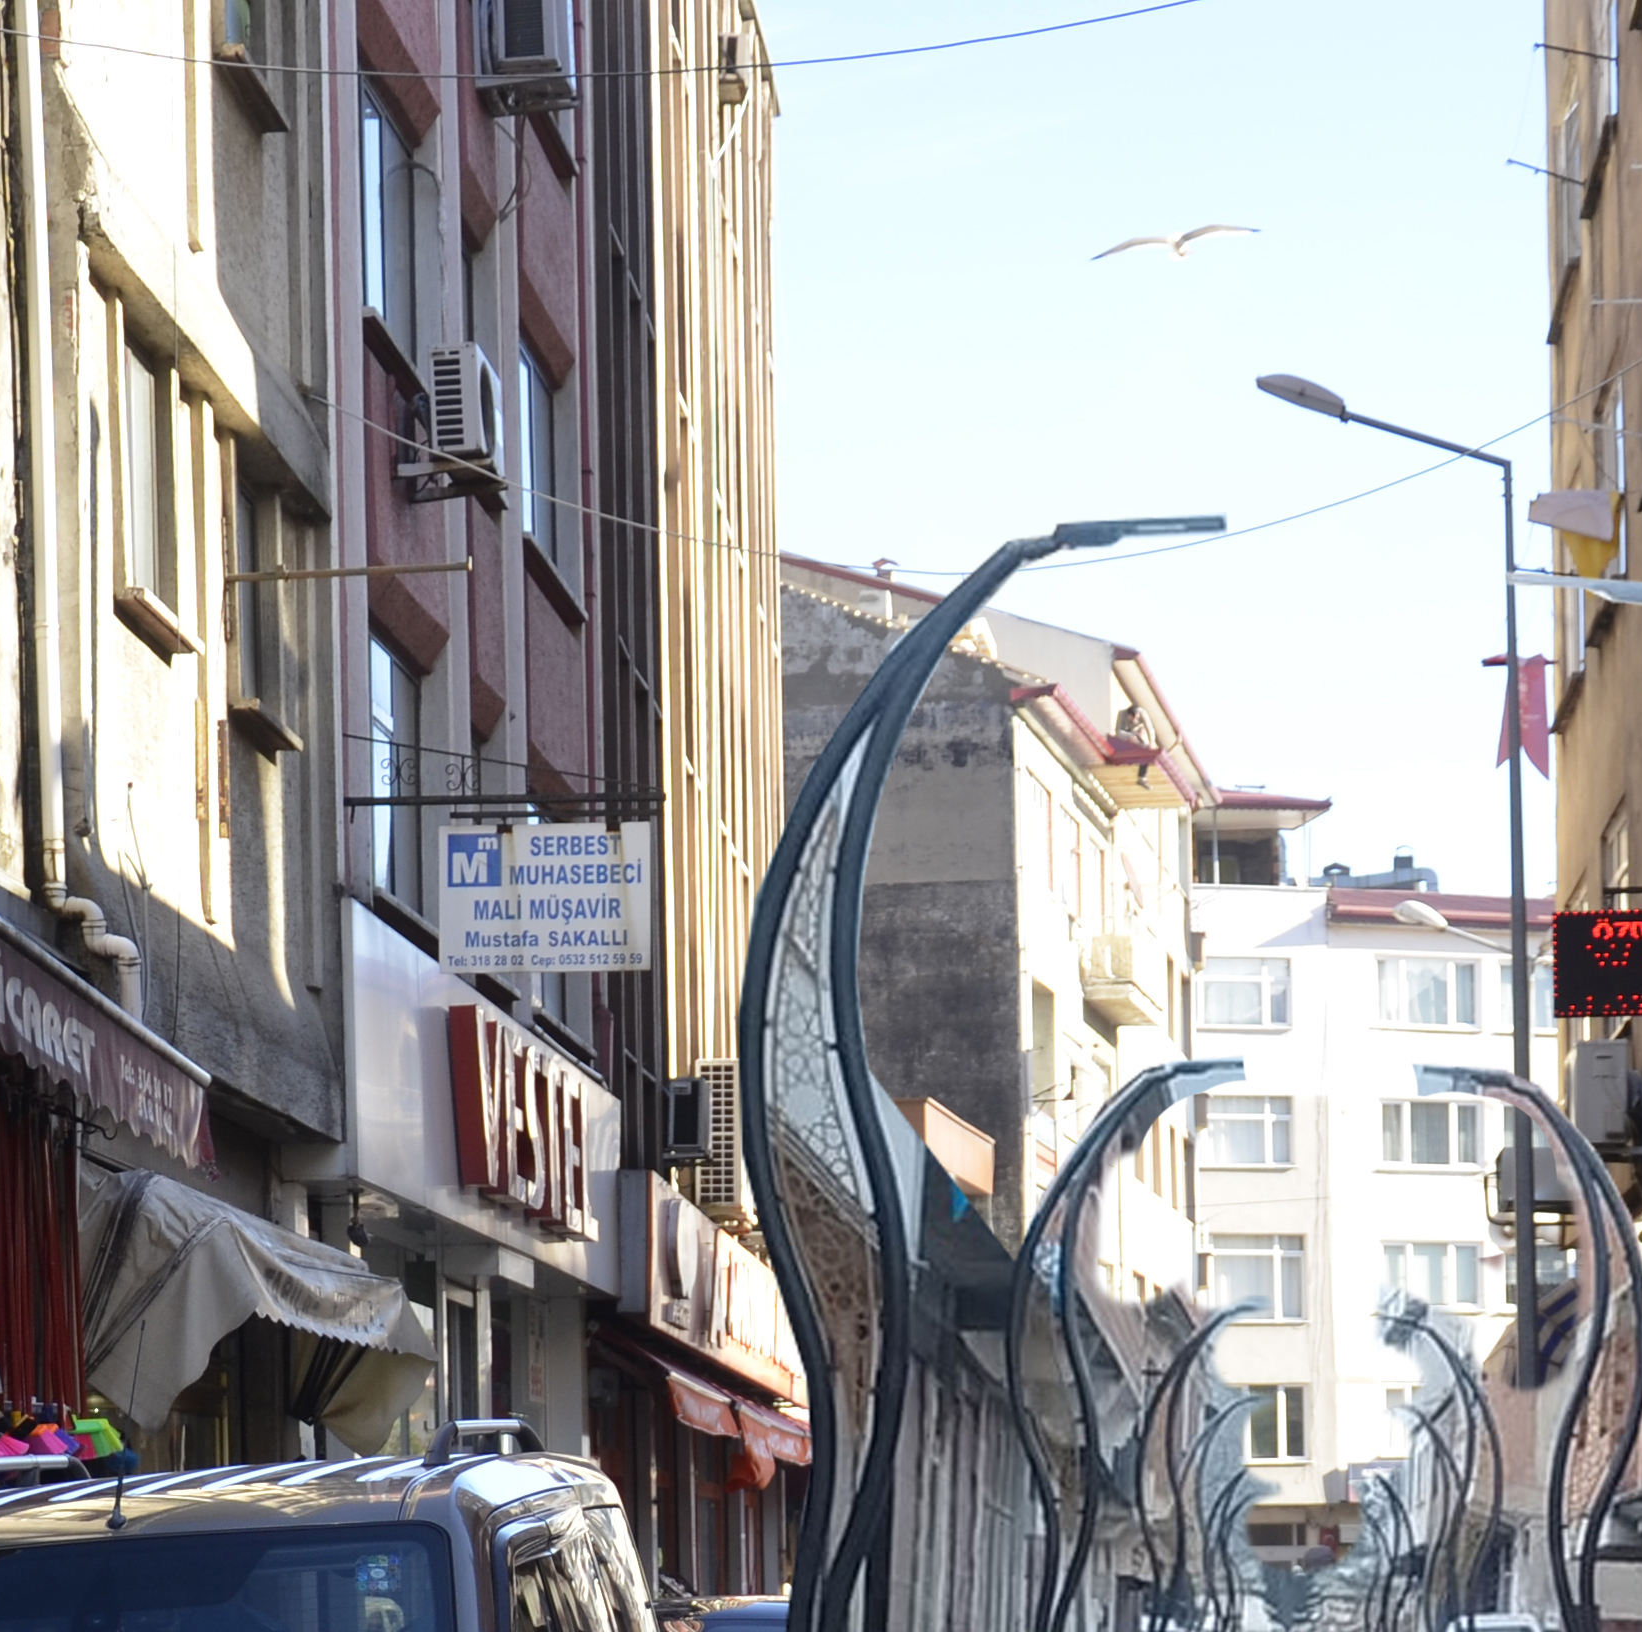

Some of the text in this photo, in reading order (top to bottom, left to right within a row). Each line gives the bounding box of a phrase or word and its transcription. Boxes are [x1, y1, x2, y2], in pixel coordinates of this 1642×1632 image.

[530, 835, 621, 856] SERBEST
[509, 859, 641, 885] MUHASEBECİ
[474, 893, 621, 925] MALİ MÜŞAVİR
[465, 930, 628, 948] Mustafa SAKALLI
[448, 953, 642, 968] Tel: 318 28 02 Cep: 0532 512 59 59
[449, 1004, 599, 1243] VESTEL
